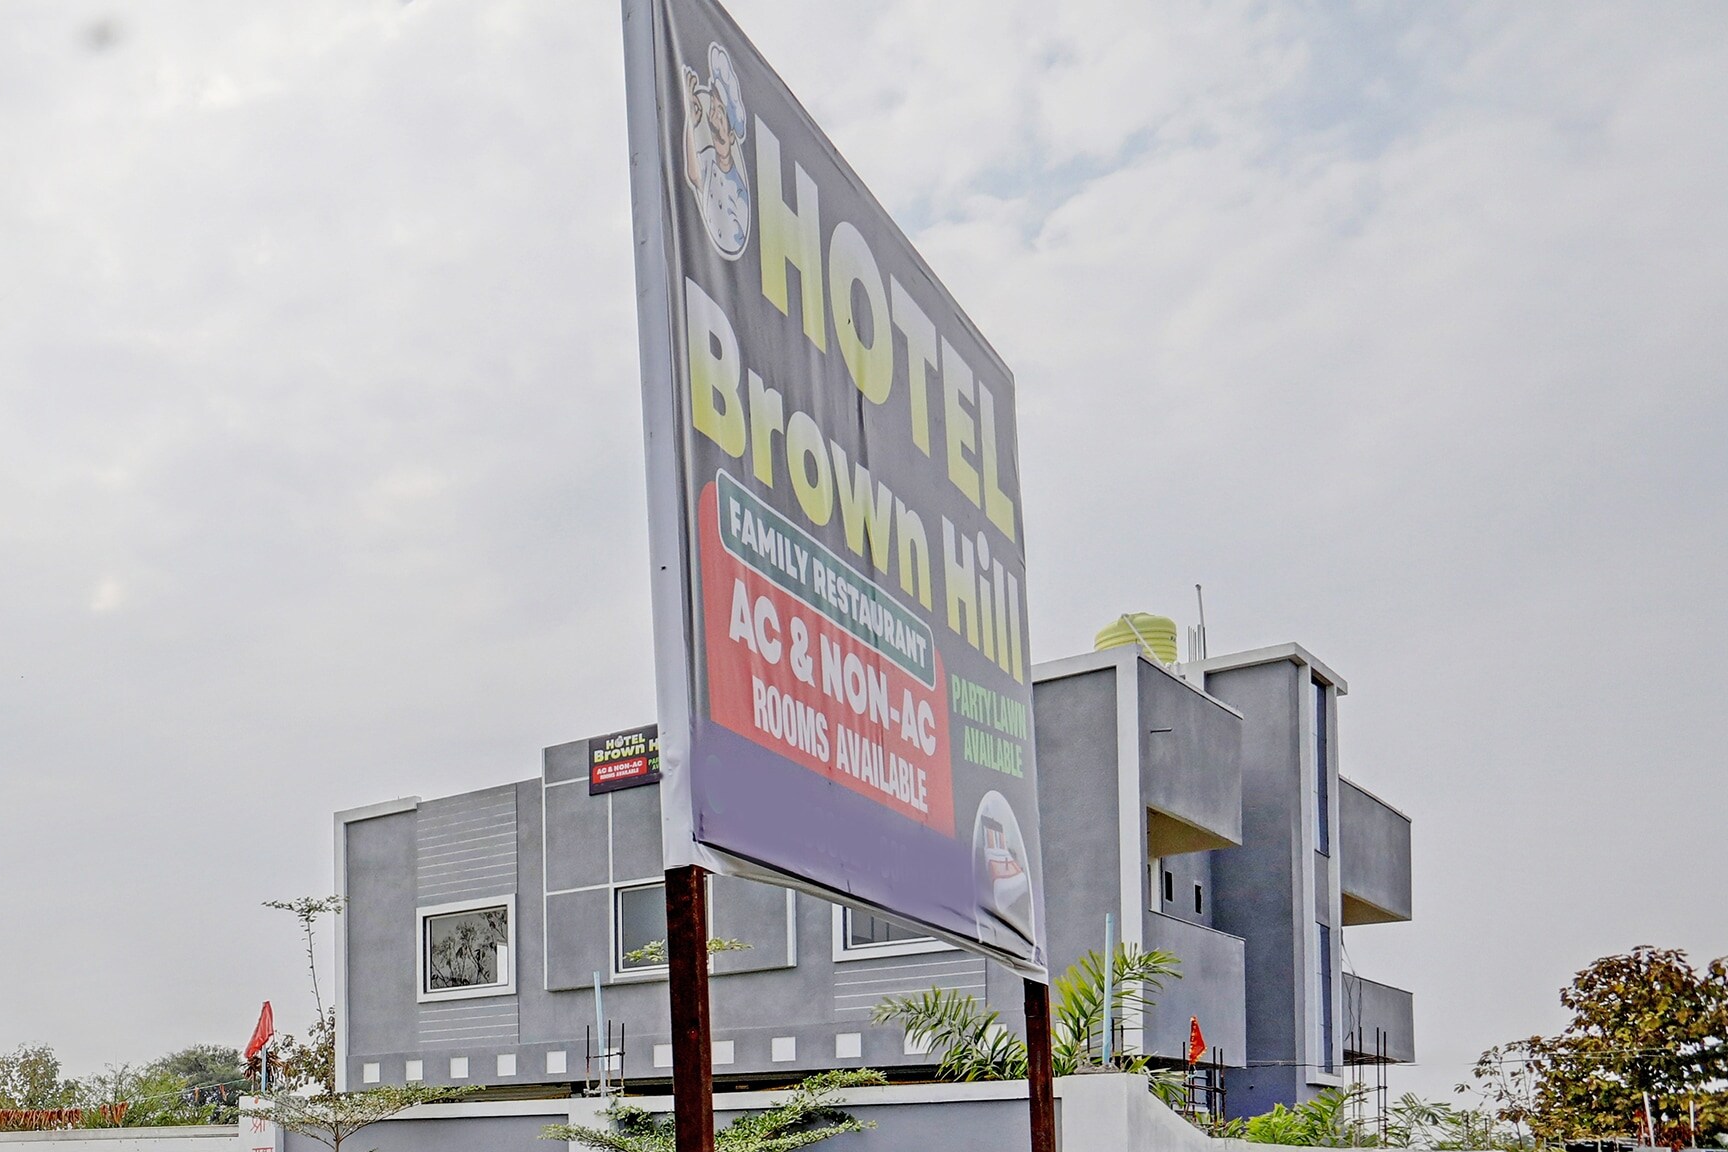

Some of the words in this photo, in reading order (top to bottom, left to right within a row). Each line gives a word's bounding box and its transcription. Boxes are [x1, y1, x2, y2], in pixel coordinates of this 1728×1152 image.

[754, 113, 1016, 544] HOTEL
[686, 276, 933, 613] Brown
[942, 514, 1024, 686] Hill
[729, 496, 809, 586] FAMILY
[812, 556, 927, 669] RESTAURANT
[729, 577, 782, 665] AC
[790, 616, 816, 688] &
[820, 632, 937, 757] NON-AC
[952, 673, 992, 727] PARTY
[992, 691, 1028, 741] LAWN
[594, 743, 645, 763] Brown
[614, 760, 643, 772] NON-AC
[752, 674, 830, 763] ROOMS
[836, 723, 929, 814] AVAILABLE
[964, 725, 1024, 779] AVAILABLE
